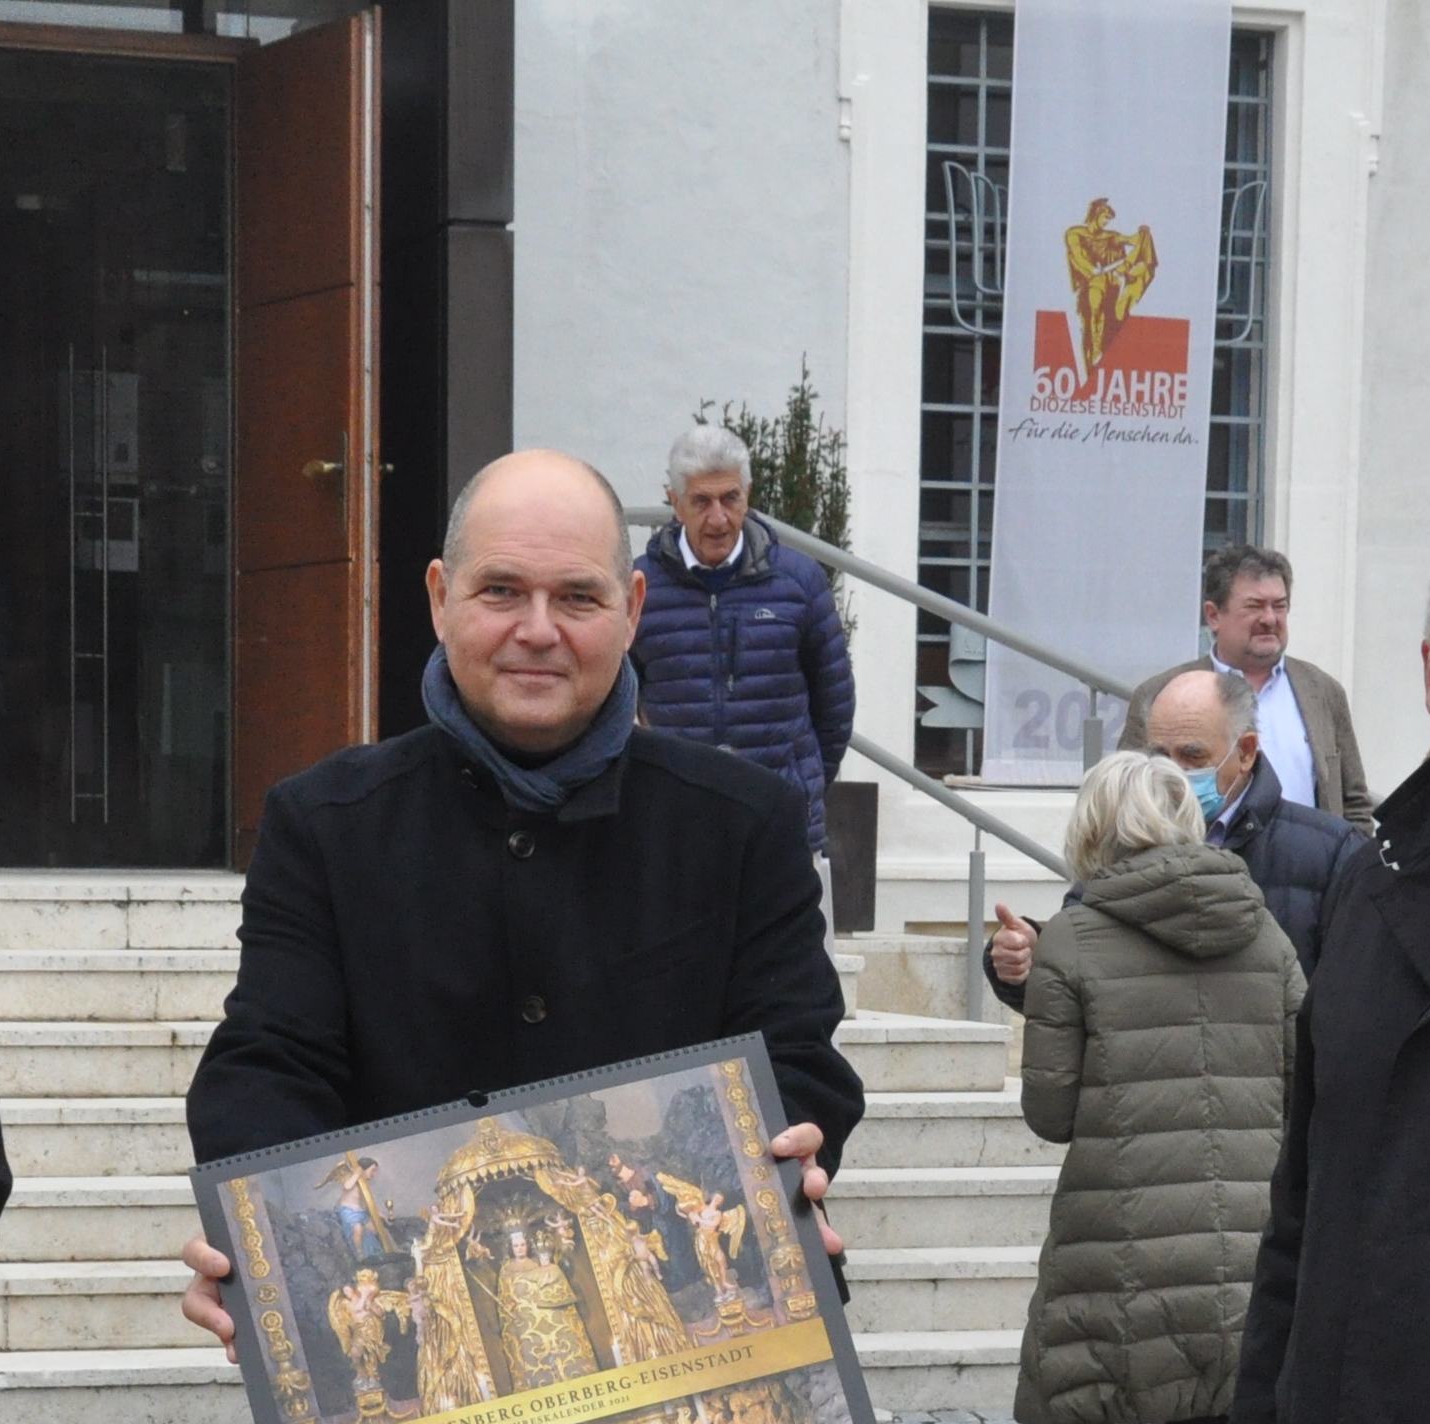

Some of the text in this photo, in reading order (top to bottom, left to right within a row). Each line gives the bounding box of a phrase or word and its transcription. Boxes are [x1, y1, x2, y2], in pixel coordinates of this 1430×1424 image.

[1033, 365, 1188, 406] 60 JAHRE
[1029, 394, 1186, 420] DIÖZESE EISENSTADT
[1008, 416, 1200, 449] für die Menschen da.
[529, 1345, 754, 1413] OBERBERG-EISENSTADT
